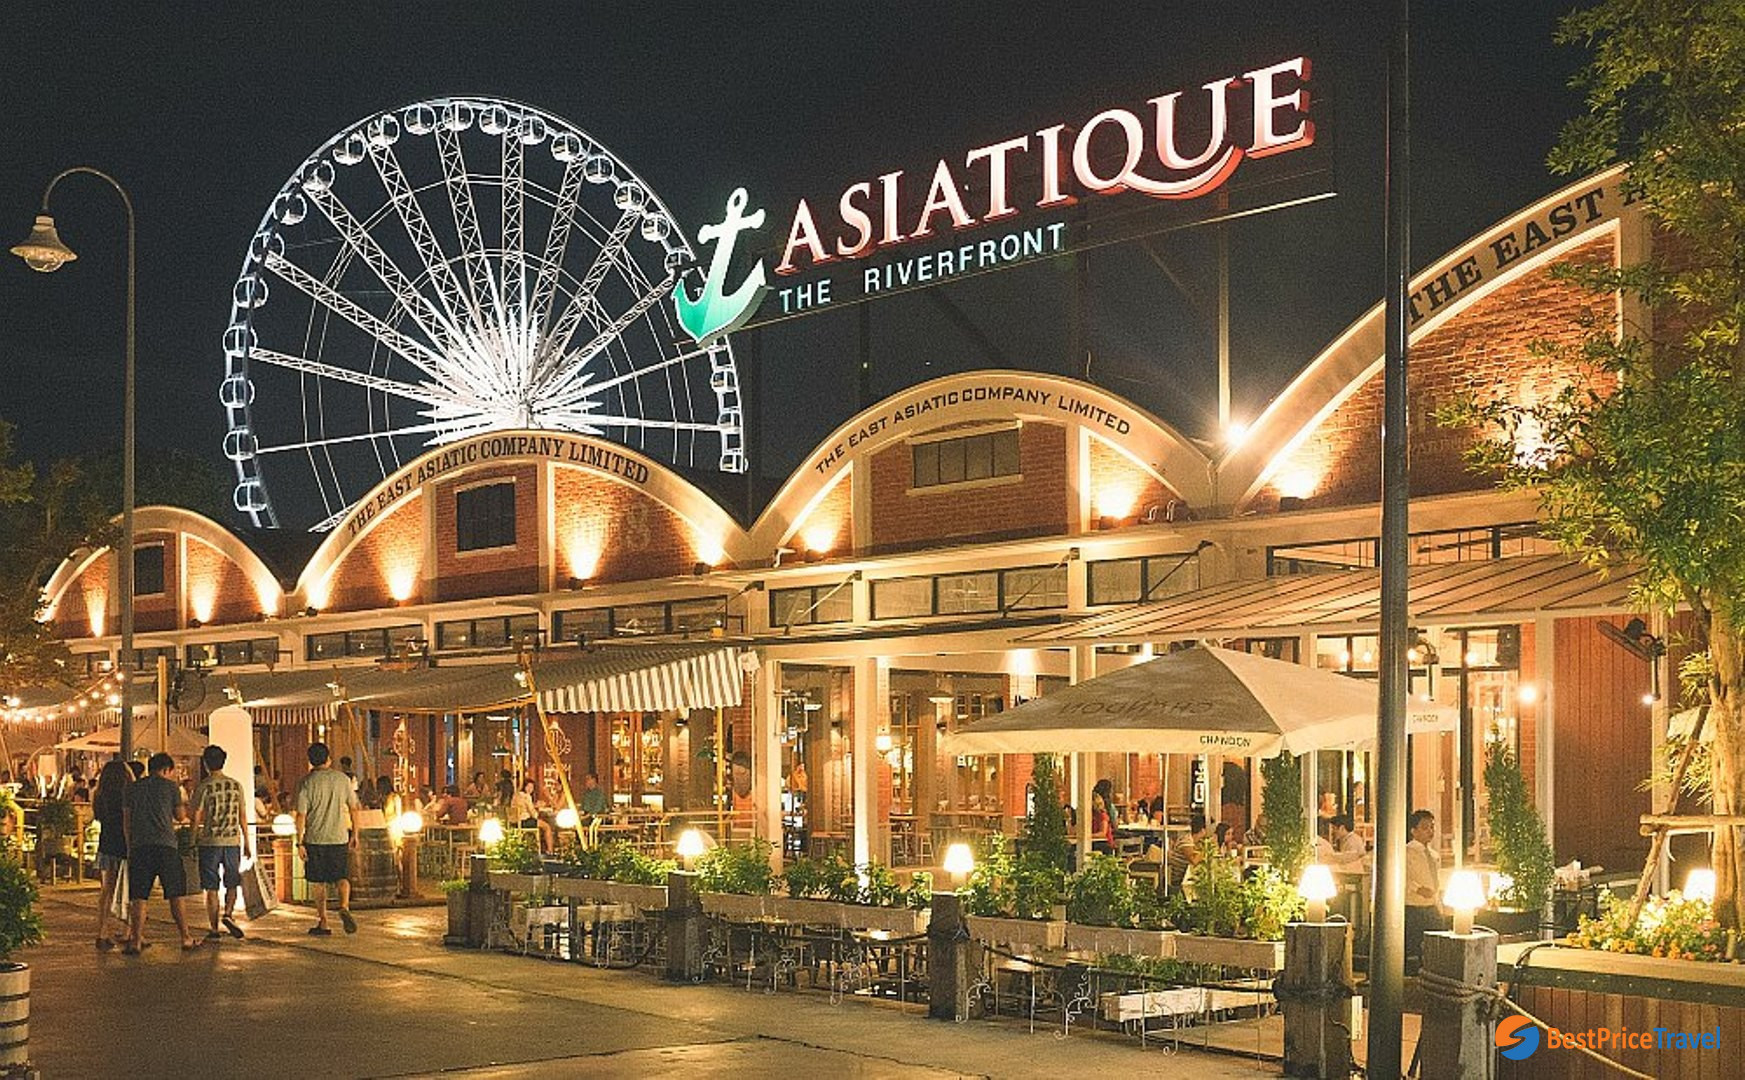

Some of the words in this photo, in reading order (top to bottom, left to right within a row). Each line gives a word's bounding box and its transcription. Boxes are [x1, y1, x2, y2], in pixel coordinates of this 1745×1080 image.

[775, 57, 1313, 275] ASIATIQUE
[779, 279, 831, 313] THE
[864, 222, 1066, 293] RIVERFRONT
[1408, 255, 1482, 325] THE
[1489, 188, 1604, 269] EAST
[816, 443, 844, 474] THE
[849, 416, 888, 447] EAST
[893, 391, 959, 424] ASIATIC
[962, 386, 1051, 405] COMPANY
[1058, 395, 1131, 436] LIMITED
[347, 501, 376, 538] THE
[376, 473, 412, 510] EAST
[417, 444, 477, 484] ASIATIC
[480, 436, 564, 458] COMPANY
[569, 441, 649, 485] LIMITED
[1199, 735, 1252, 747] CHANDON
